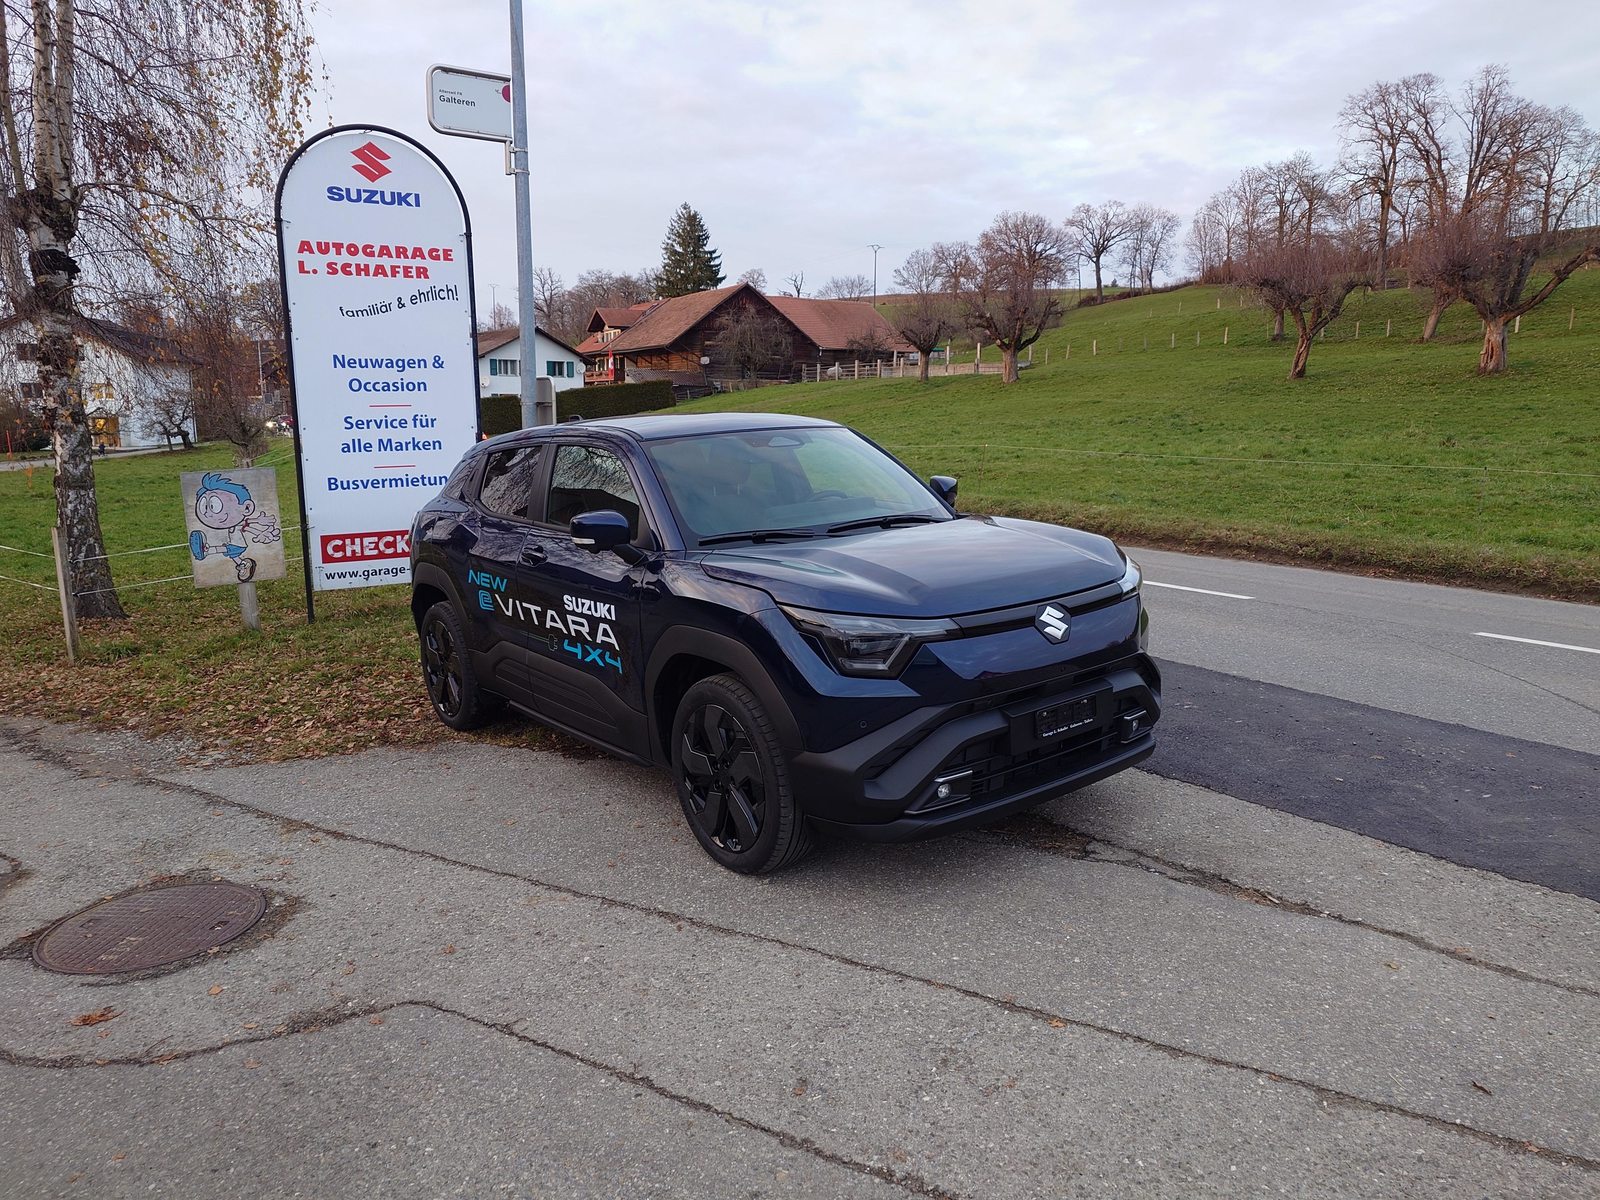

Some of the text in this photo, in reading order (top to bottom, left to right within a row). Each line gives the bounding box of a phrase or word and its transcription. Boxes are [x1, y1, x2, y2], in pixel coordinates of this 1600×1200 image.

[439, 95, 476, 106] Galteren
[326, 185, 421, 208] SUZUKI
[297, 240, 454, 262] AUTOGARAGE
[297, 260, 430, 280] L. SCHAFER
[338, 284, 459, 318] familiär & ehrlich!
[332, 354, 445, 373] Neuwagen &
[348, 378, 428, 393] Occasion
[343, 414, 437, 430] Service für
[340, 437, 443, 454] alle Marken
[327, 473, 449, 491] Busvermietun
[326, 534, 410, 559] CHECK
[468, 570, 507, 592] NEW
[562, 594, 616, 621] SUZUKI
